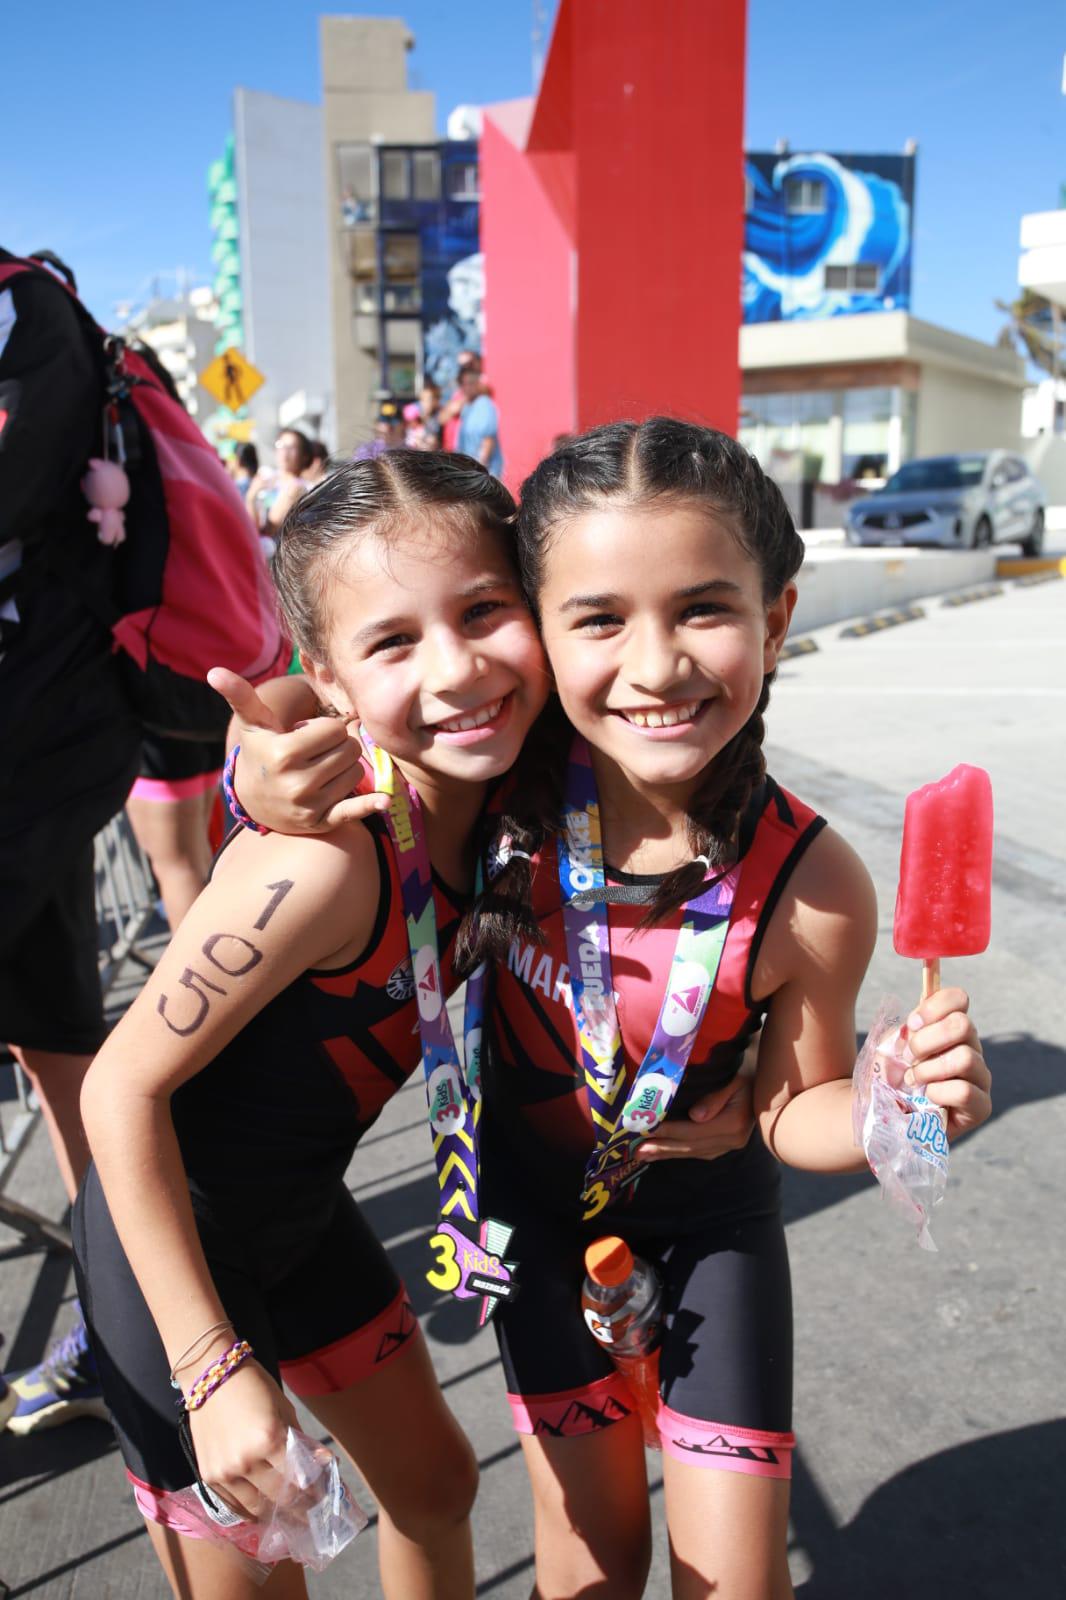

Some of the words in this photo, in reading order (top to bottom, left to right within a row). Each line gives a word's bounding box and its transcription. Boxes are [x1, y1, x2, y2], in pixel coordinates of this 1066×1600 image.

[436, 1101, 461, 1123] 3
[631, 1110, 656, 1125] 3
[582, 1180, 611, 1221] 3
[425, 1232, 462, 1293] 3
